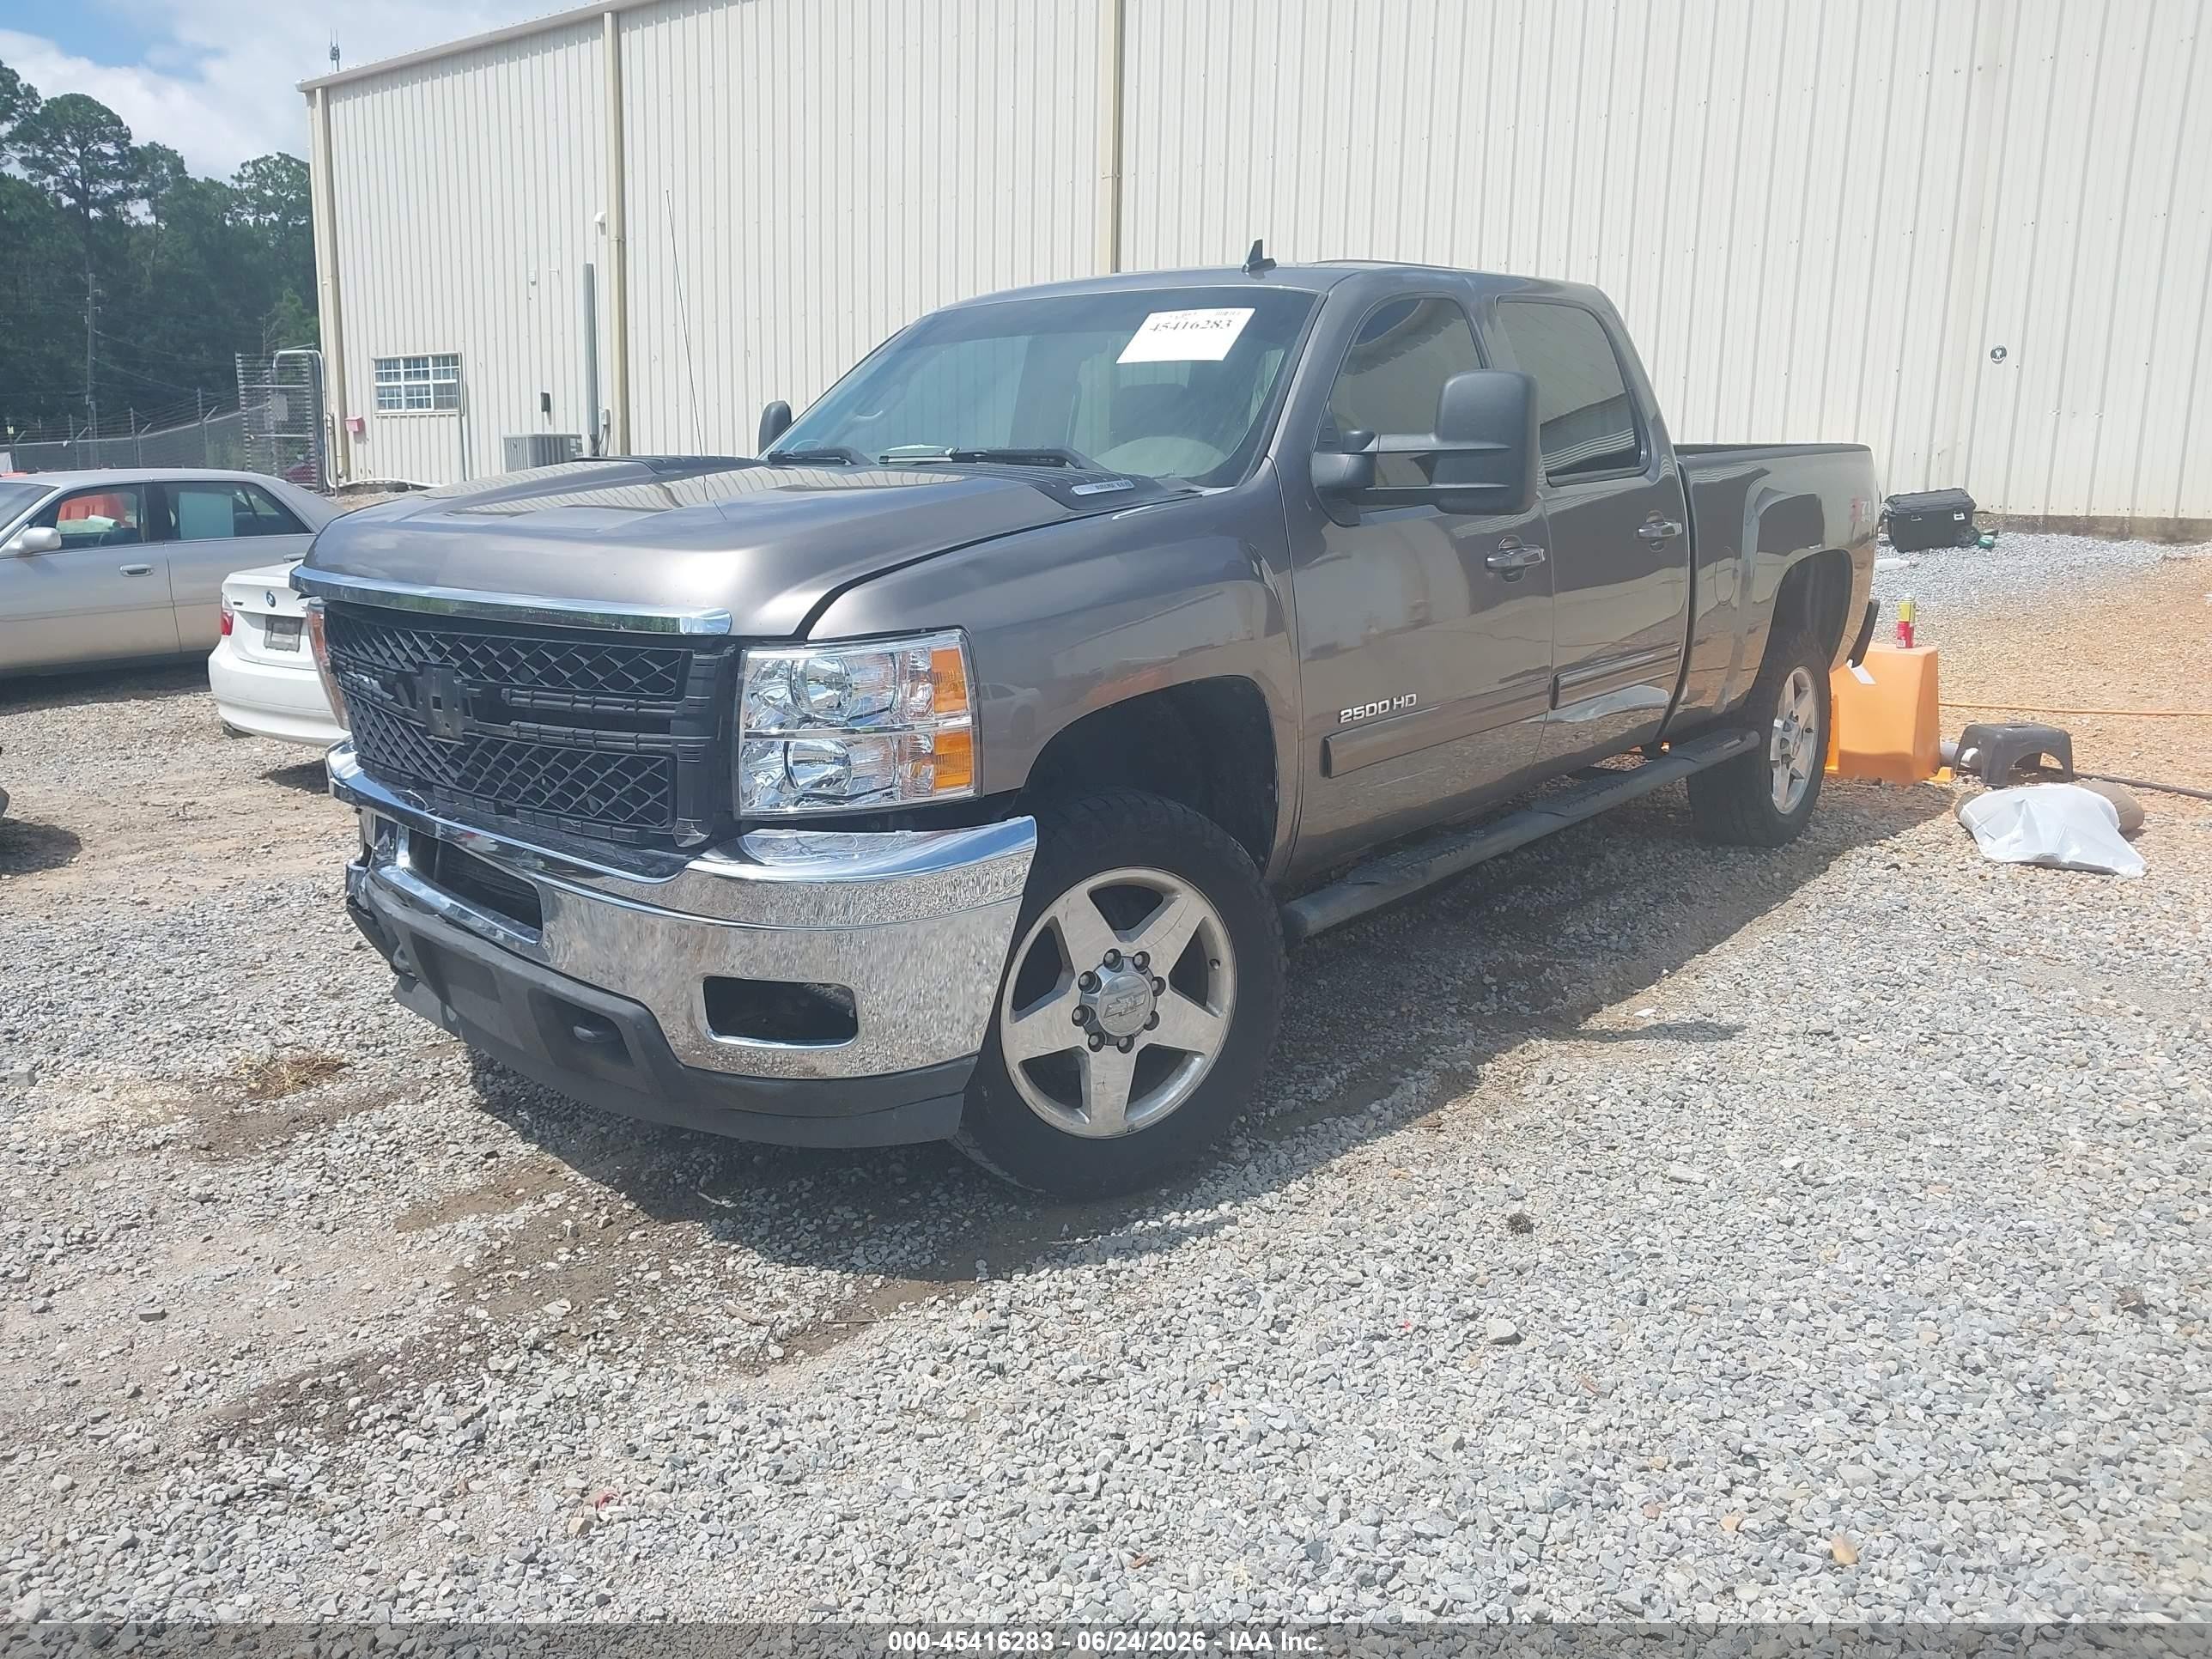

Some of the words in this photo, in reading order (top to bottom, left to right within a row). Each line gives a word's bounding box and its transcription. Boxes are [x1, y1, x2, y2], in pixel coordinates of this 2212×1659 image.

[1149, 319, 1233, 332] 45416283
[1340, 699, 1390, 723] 2500
[1392, 693, 1418, 711] HD
